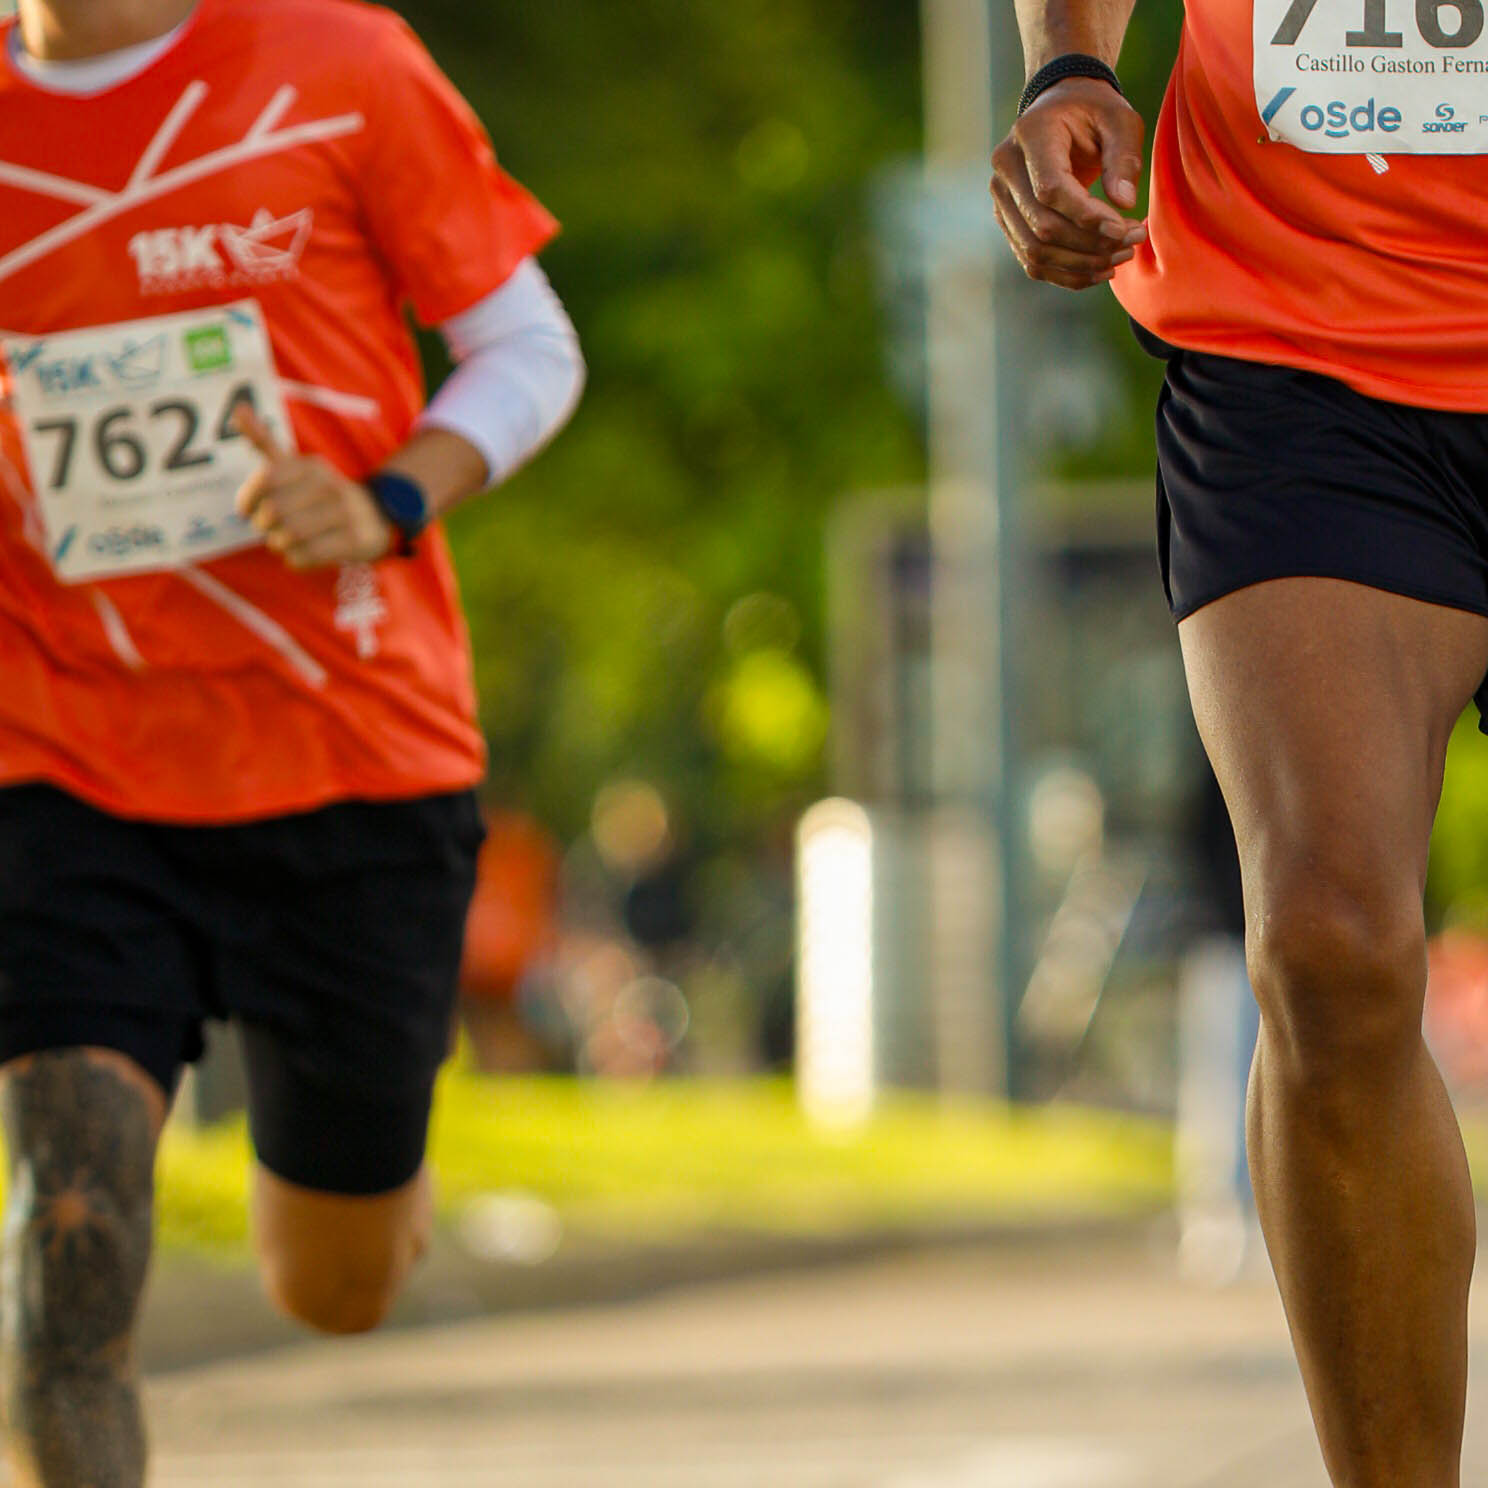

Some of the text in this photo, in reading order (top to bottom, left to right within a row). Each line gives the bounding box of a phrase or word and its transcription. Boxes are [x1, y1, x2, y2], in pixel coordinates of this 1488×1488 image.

[1296, 53, 1365, 72] Castillo
[1371, 55, 1435, 73] Gaston
[1300, 97, 1402, 133] osde
[127, 224, 222, 276] 15K
[33, 381, 270, 489] 7624
